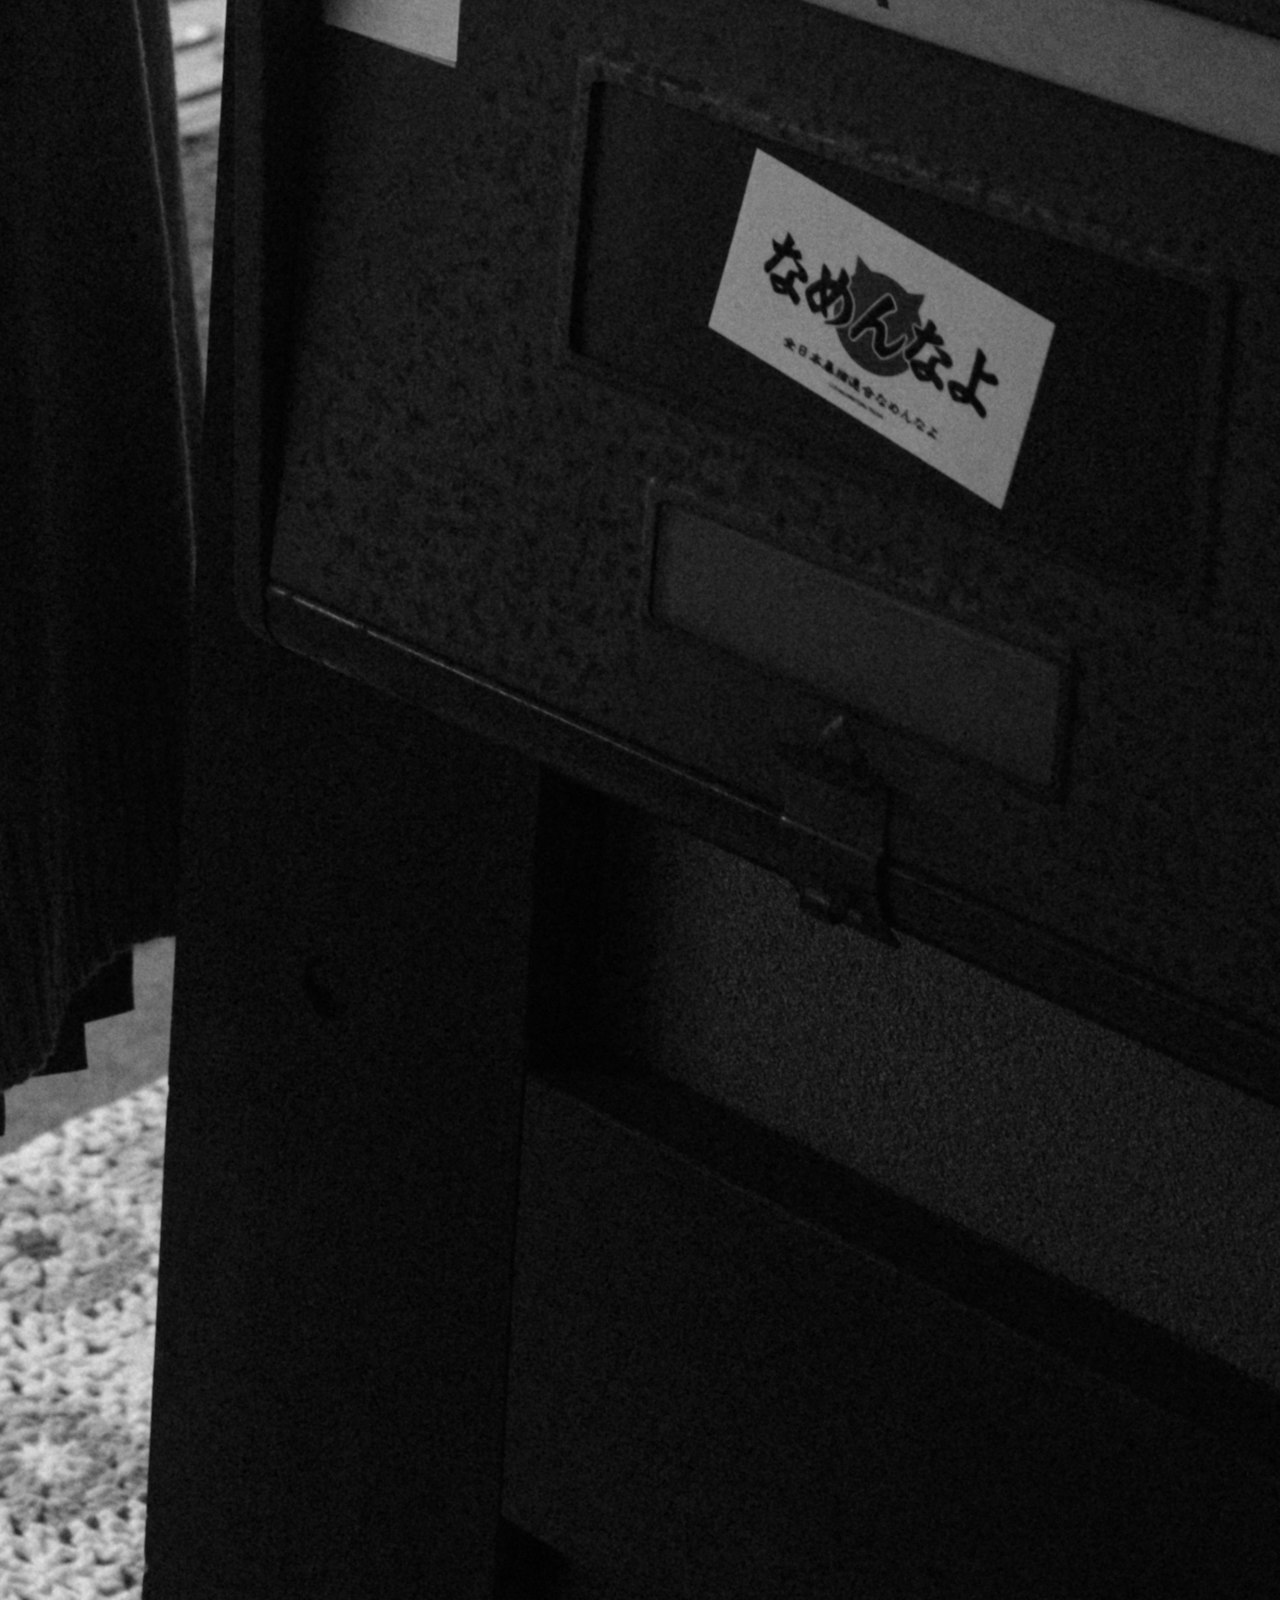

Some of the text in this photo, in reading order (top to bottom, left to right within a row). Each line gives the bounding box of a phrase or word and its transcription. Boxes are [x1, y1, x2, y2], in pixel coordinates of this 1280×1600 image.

[763, 231, 1000, 419] なめんなよ
